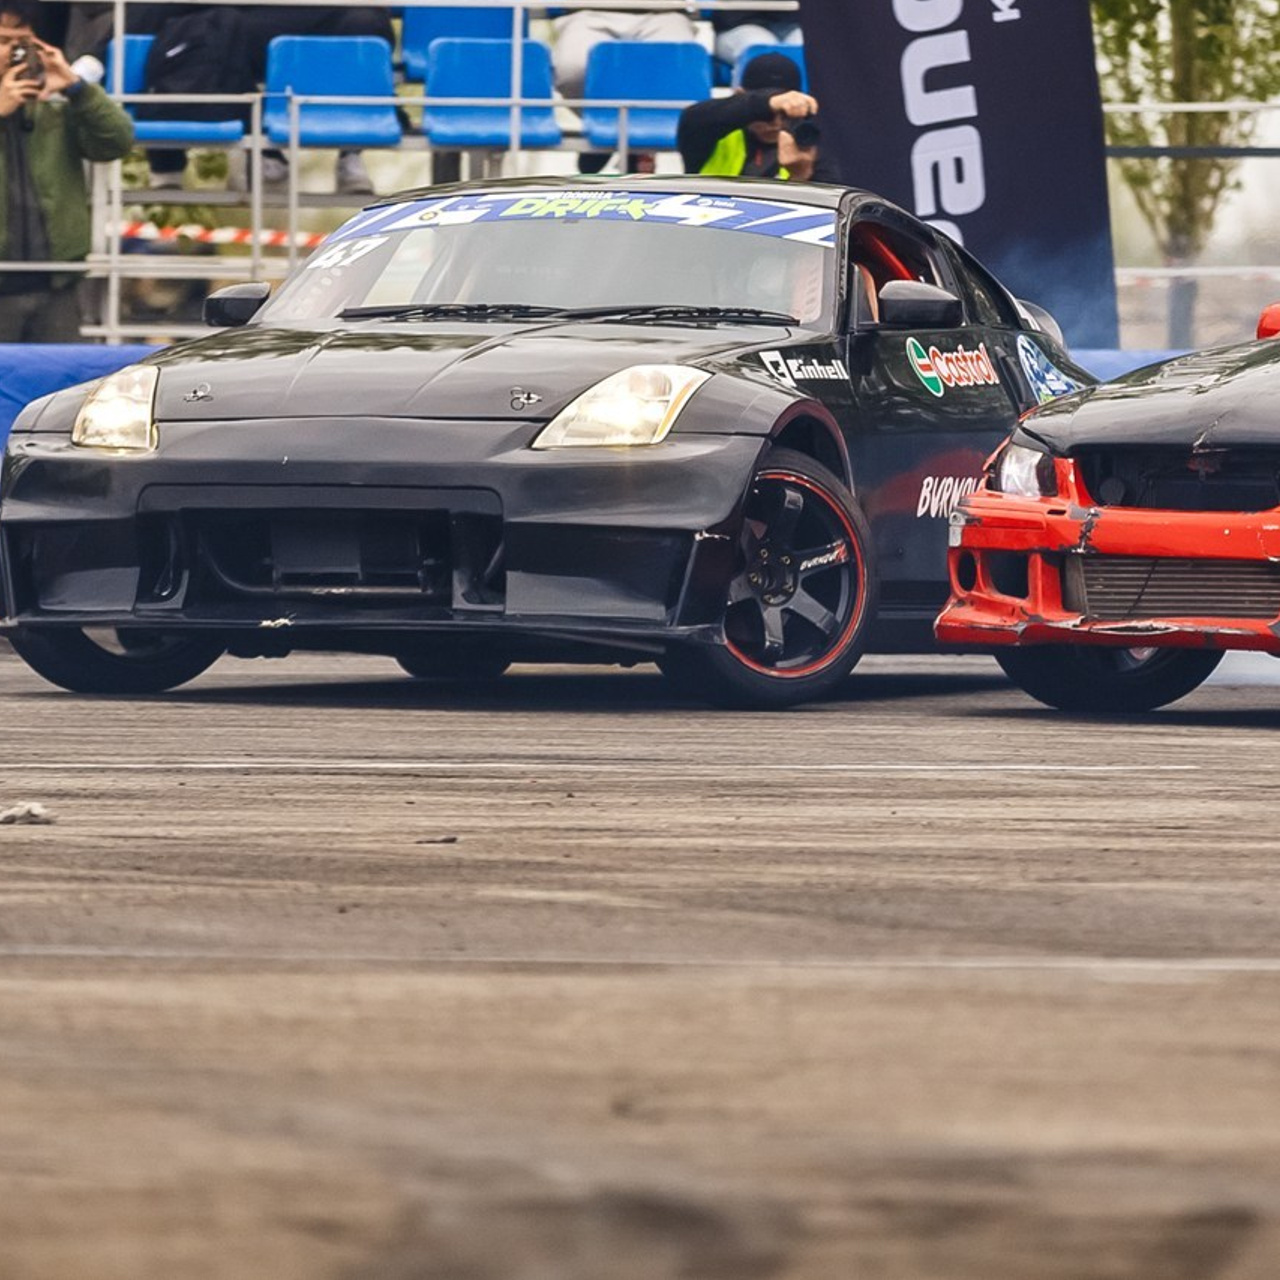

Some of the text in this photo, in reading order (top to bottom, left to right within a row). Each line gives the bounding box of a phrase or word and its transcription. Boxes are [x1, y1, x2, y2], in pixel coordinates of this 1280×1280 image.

[499, 198, 656, 220] DRIFT
[306, 236, 391, 269] 47
[786, 359, 850, 380] Einhell
[929, 342, 1000, 387] Castrol
